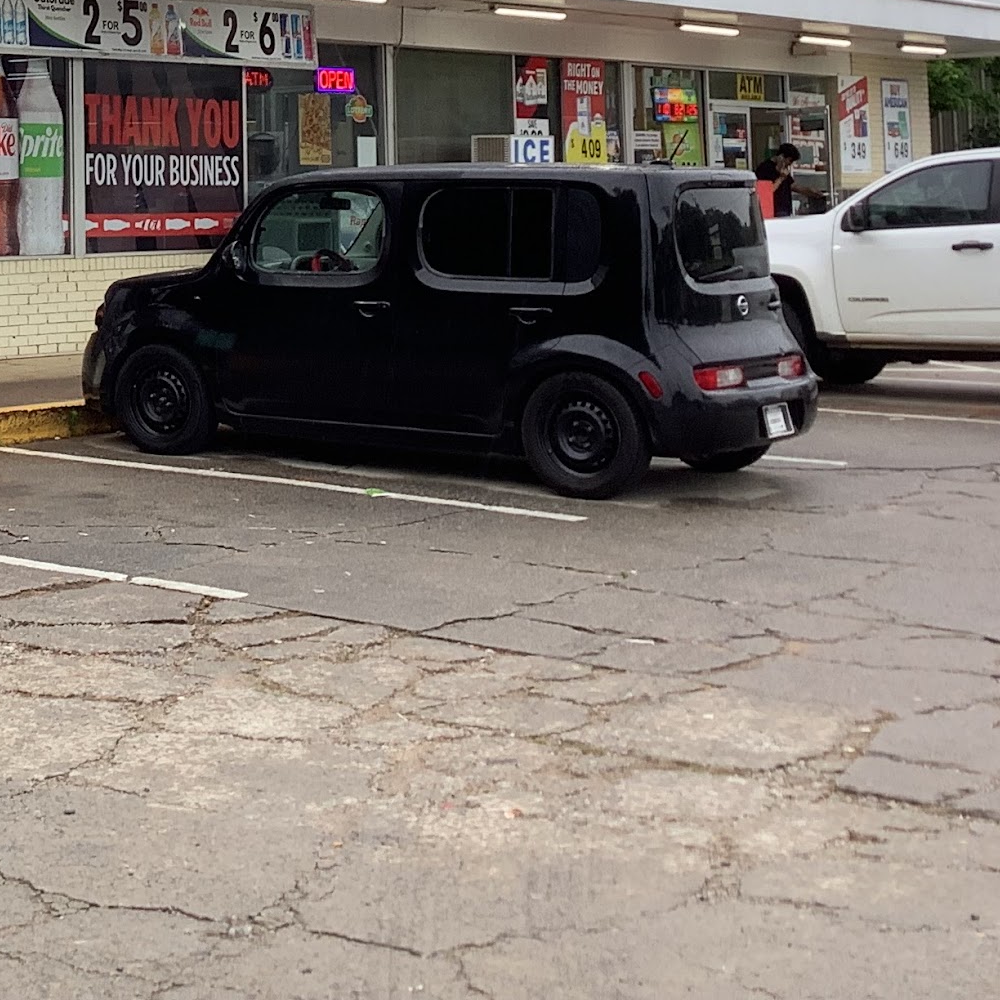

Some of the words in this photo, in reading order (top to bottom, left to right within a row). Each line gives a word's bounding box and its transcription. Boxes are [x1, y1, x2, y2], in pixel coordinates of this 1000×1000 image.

[102, 20, 119, 31] FOR
[223, 9, 239, 53] 2
[240, 30, 255, 40] FOR
[244, 71, 269, 87] ATM
[320, 70, 354, 90] OPEN
[567, 62, 591, 78] RIGHT
[564, 79, 576, 91] THE
[576, 80, 604, 95] MONEY
[739, 74, 762, 94] ATM
[85, 94, 180, 147] THANK
[186, 98, 240, 148] YOU
[20, 126, 64, 165] prite
[514, 138, 550, 163] ICE
[581, 138, 602, 158] 409
[851, 142, 866, 159] 349
[85, 153, 117, 186] FOR
[121, 154, 165, 186] YOUR
[169, 155, 240, 186] BUSINESS
